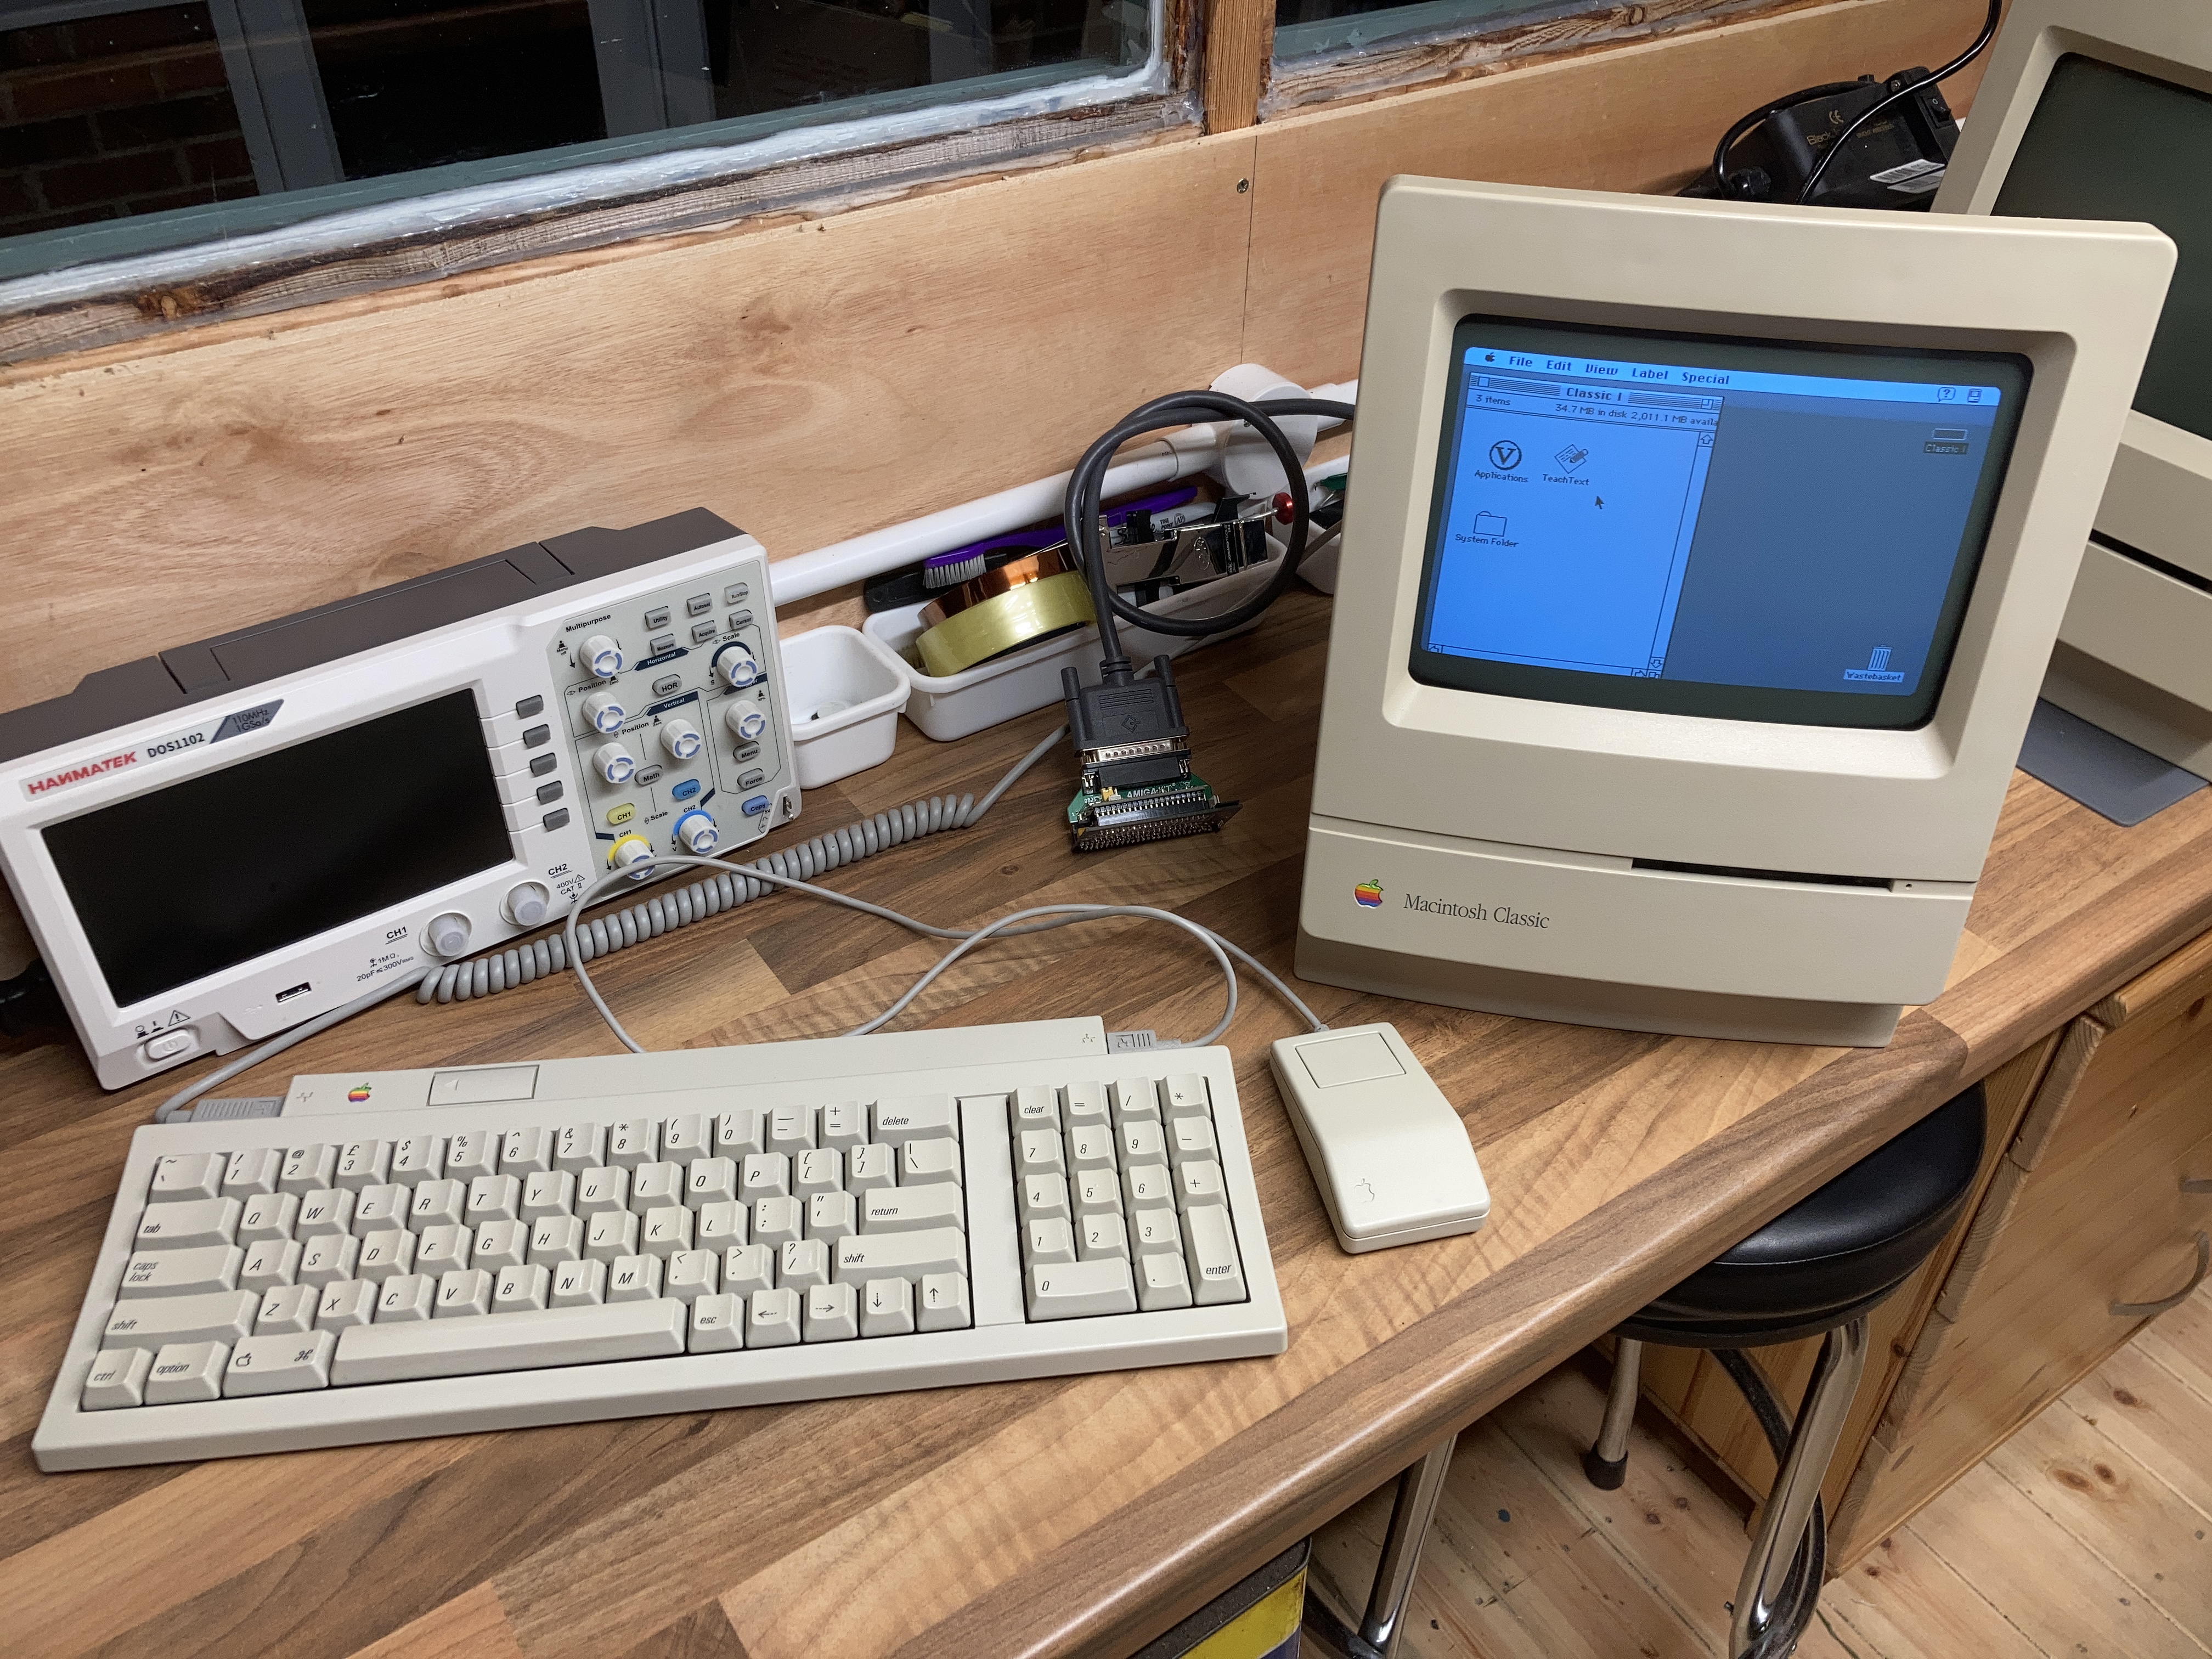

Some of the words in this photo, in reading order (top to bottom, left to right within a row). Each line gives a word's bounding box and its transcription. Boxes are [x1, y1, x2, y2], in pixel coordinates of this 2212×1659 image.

[1509, 356, 1533, 368] File
[1547, 360, 1572, 372] Edit
[1585, 364, 1618, 376] View
[1632, 368, 1668, 380] Label
[1681, 372, 1730, 385] Special
[1567, 387, 1611, 400] Classic
[1476, 394, 1482, 403] 3
[1485, 396, 1511, 406] items
[1555, 404, 1578, 413] 34.7
[1580, 407, 1594, 415] MB
[1609, 410, 1627, 418] disk
[1926, 444, 1959, 453] Classic
[1474, 470, 1529, 484] Applications
[1542, 473, 1590, 486] TeachText
[1455, 533, 1489, 545] System
[1491, 538, 1519, 548] Folder
[731, 591, 748, 599] Run/Stop
[566, 614, 611, 633] Multipurpose
[699, 629, 715, 637] Acquire
[723, 633, 740, 641] Scale
[657, 643, 674, 651] Measure
[647, 652, 676, 665] Horizontal
[1846, 671, 1901, 682] Wastebasket
[578, 680, 606, 692] Position
[662, 682, 678, 692] HOR
[663, 697, 685, 708] Vertical
[232, 708, 269, 724] 110MHz
[622, 721, 650, 735] Position
[147, 732, 205, 758] DOS1102
[741, 748, 758, 758] Menu
[643, 772, 660, 782] Math
[745, 776, 763, 786] Force
[682, 787, 696, 797] CH2
[617, 811, 631, 820] CH1
[651, 811, 668, 821] Scale
[619, 829, 631, 837] CH1
[548, 864, 568, 875] CH2
[556, 878, 574, 889] 400V
[561, 885, 574, 895] CAT
[1403, 894, 1487, 921] Macintosh
[1494, 907, 1550, 928] Classic
[387, 926, 407, 939] CH1
[1024, 1105, 1045, 1114] clear
[882, 1116, 909, 1126] delete
[671, 1133, 679, 1143] 9
[563, 1143, 573, 1153] 7
[618, 1139, 626, 1149] 8
[1080, 1144, 1087, 1154] 8
[1131, 1139, 1138, 1149] 9
[455, 1152, 464, 1162] 5
[510, 1147, 518, 1158] 6
[1029, 1148, 1036, 1158] 7
[345, 1160, 354, 1170] 3
[399, 1156, 409, 1166] 4
[288, 1165, 299, 1175] 2
[751, 1170, 760, 1182] P
[586, 1186, 597, 1197] U
[1086, 1188, 1093, 1198] 5
[1138, 1183, 1145, 1193] 6
[476, 1194, 486, 1205] T
[532, 1189, 541, 1201] Y
[1033, 1192, 1040, 1202] 4
[363, 1203, 374, 1214] E
[419, 1199, 431, 1210] R
[306, 1207, 324, 1219] W
[871, 1206, 898, 1216] return
[248, 1212, 261, 1224] Q
[143, 1223, 161, 1233] tab
[651, 1224, 661, 1235] K
[706, 1220, 713, 1231] L
[594, 1229, 605, 1240] J
[1092, 1232, 1099, 1242] 2
[1145, 1227, 1152, 1237] 3
[482, 1238, 493, 1250] G
[538, 1233, 550, 1245] H
[367, 1248, 379, 1260] D
[425, 1243, 436, 1255] F
[308, 1253, 321, 1266] S
[843, 1253, 865, 1263] shift
[133, 1261, 159, 1272] caps
[249, 1259, 262, 1271] A
[1206, 1265, 1232, 1274] enter
[129, 1272, 153, 1282] lock
[618, 1272, 634, 1284] M
[503, 1283, 515, 1294] B
[561, 1278, 574, 1289] N
[386, 1294, 398, 1305] C
[446, 1288, 457, 1300] V
[266, 1304, 280, 1316] Z
[325, 1298, 341, 1311] X
[111, 1319, 138, 1331] shift
[699, 1315, 717, 1324] esc
[156, 1362, 190, 1376] option
[93, 1371, 116, 1381] ctrl
